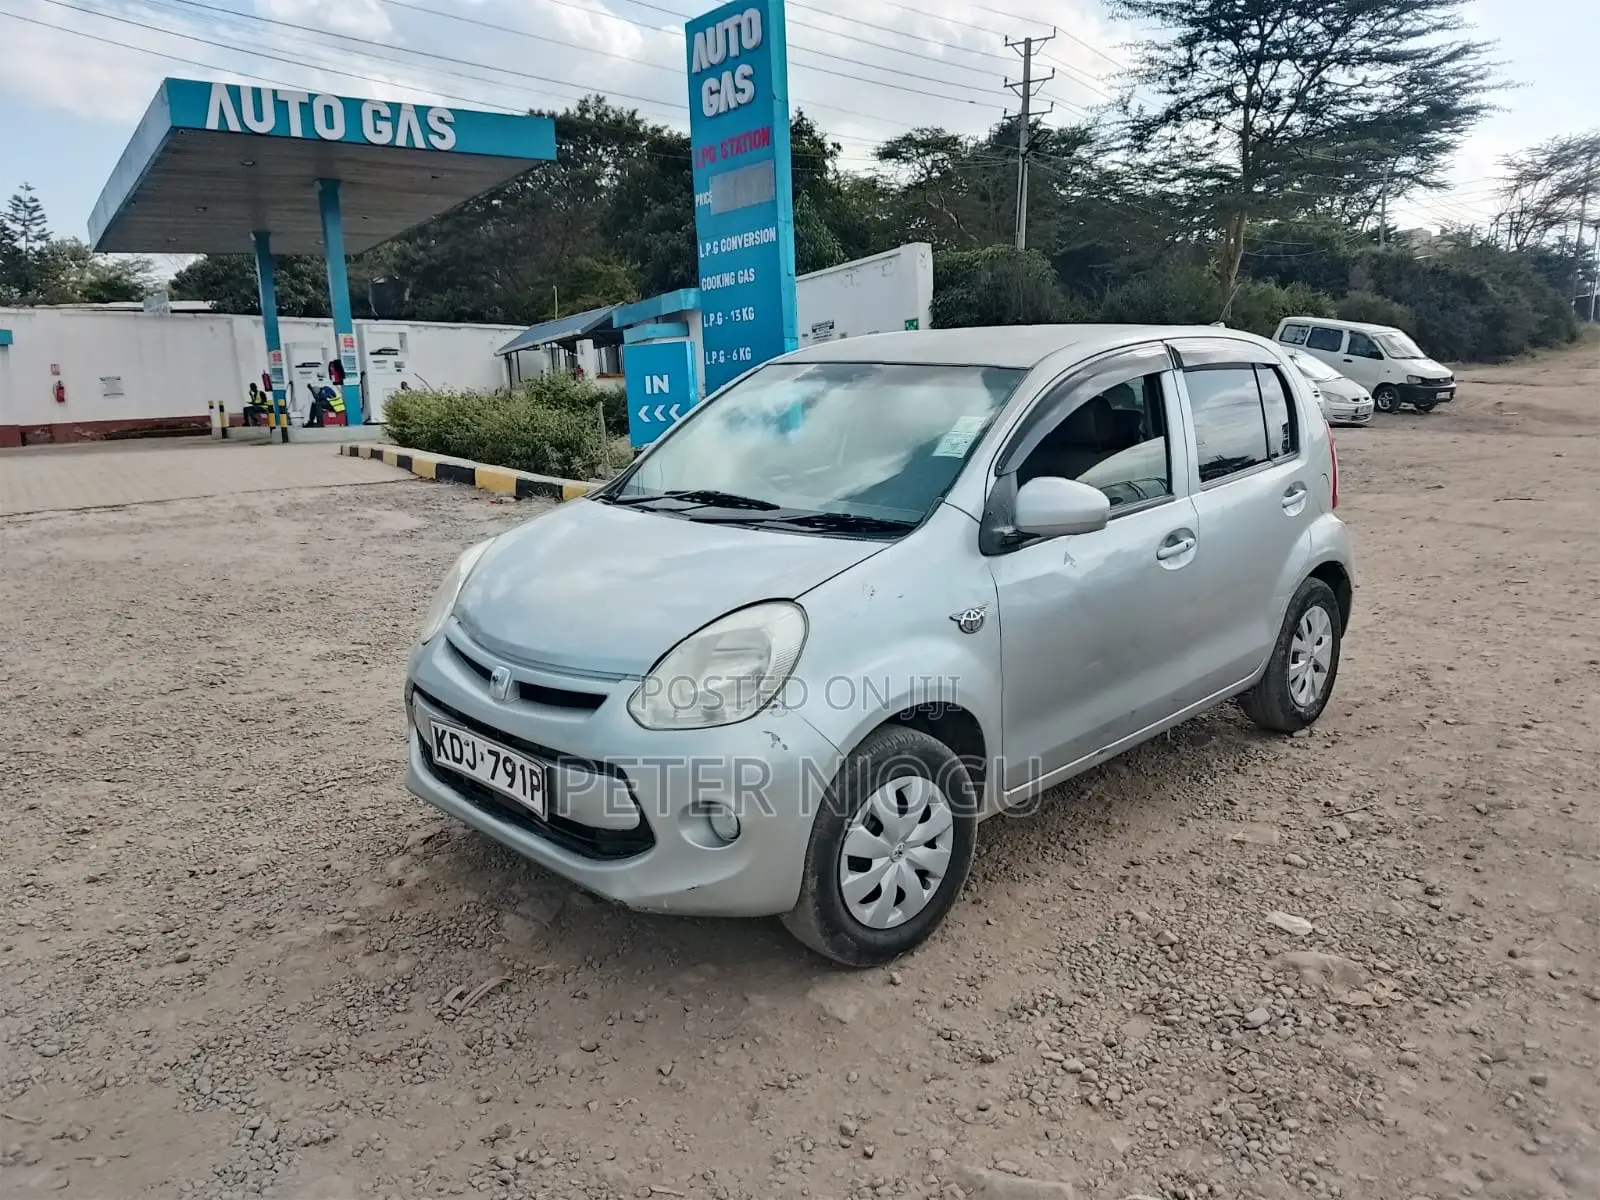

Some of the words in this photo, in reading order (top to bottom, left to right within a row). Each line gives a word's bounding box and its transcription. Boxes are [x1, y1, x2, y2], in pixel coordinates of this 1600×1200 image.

[692, 8, 762, 73] AUTO
[702, 64, 755, 117] GAS
[205, 82, 346, 141] AUTO
[361, 100, 457, 151] GAS
[695, 144, 717, 169] LPG
[720, 126, 771, 160] STATION
[720, 226, 777, 253] CONVERSION
[701, 271, 735, 292] COOKING
[737, 268, 755, 285] GAS
[730, 309, 741, 322] 13
[742, 306, 755, 322] KG
[732, 349, 738, 361] 6
[739, 347, 752, 361] KG
[645, 374, 670, 395] IN
[432, 725, 477, 771] KDJ
[487, 749, 541, 801] 791P
